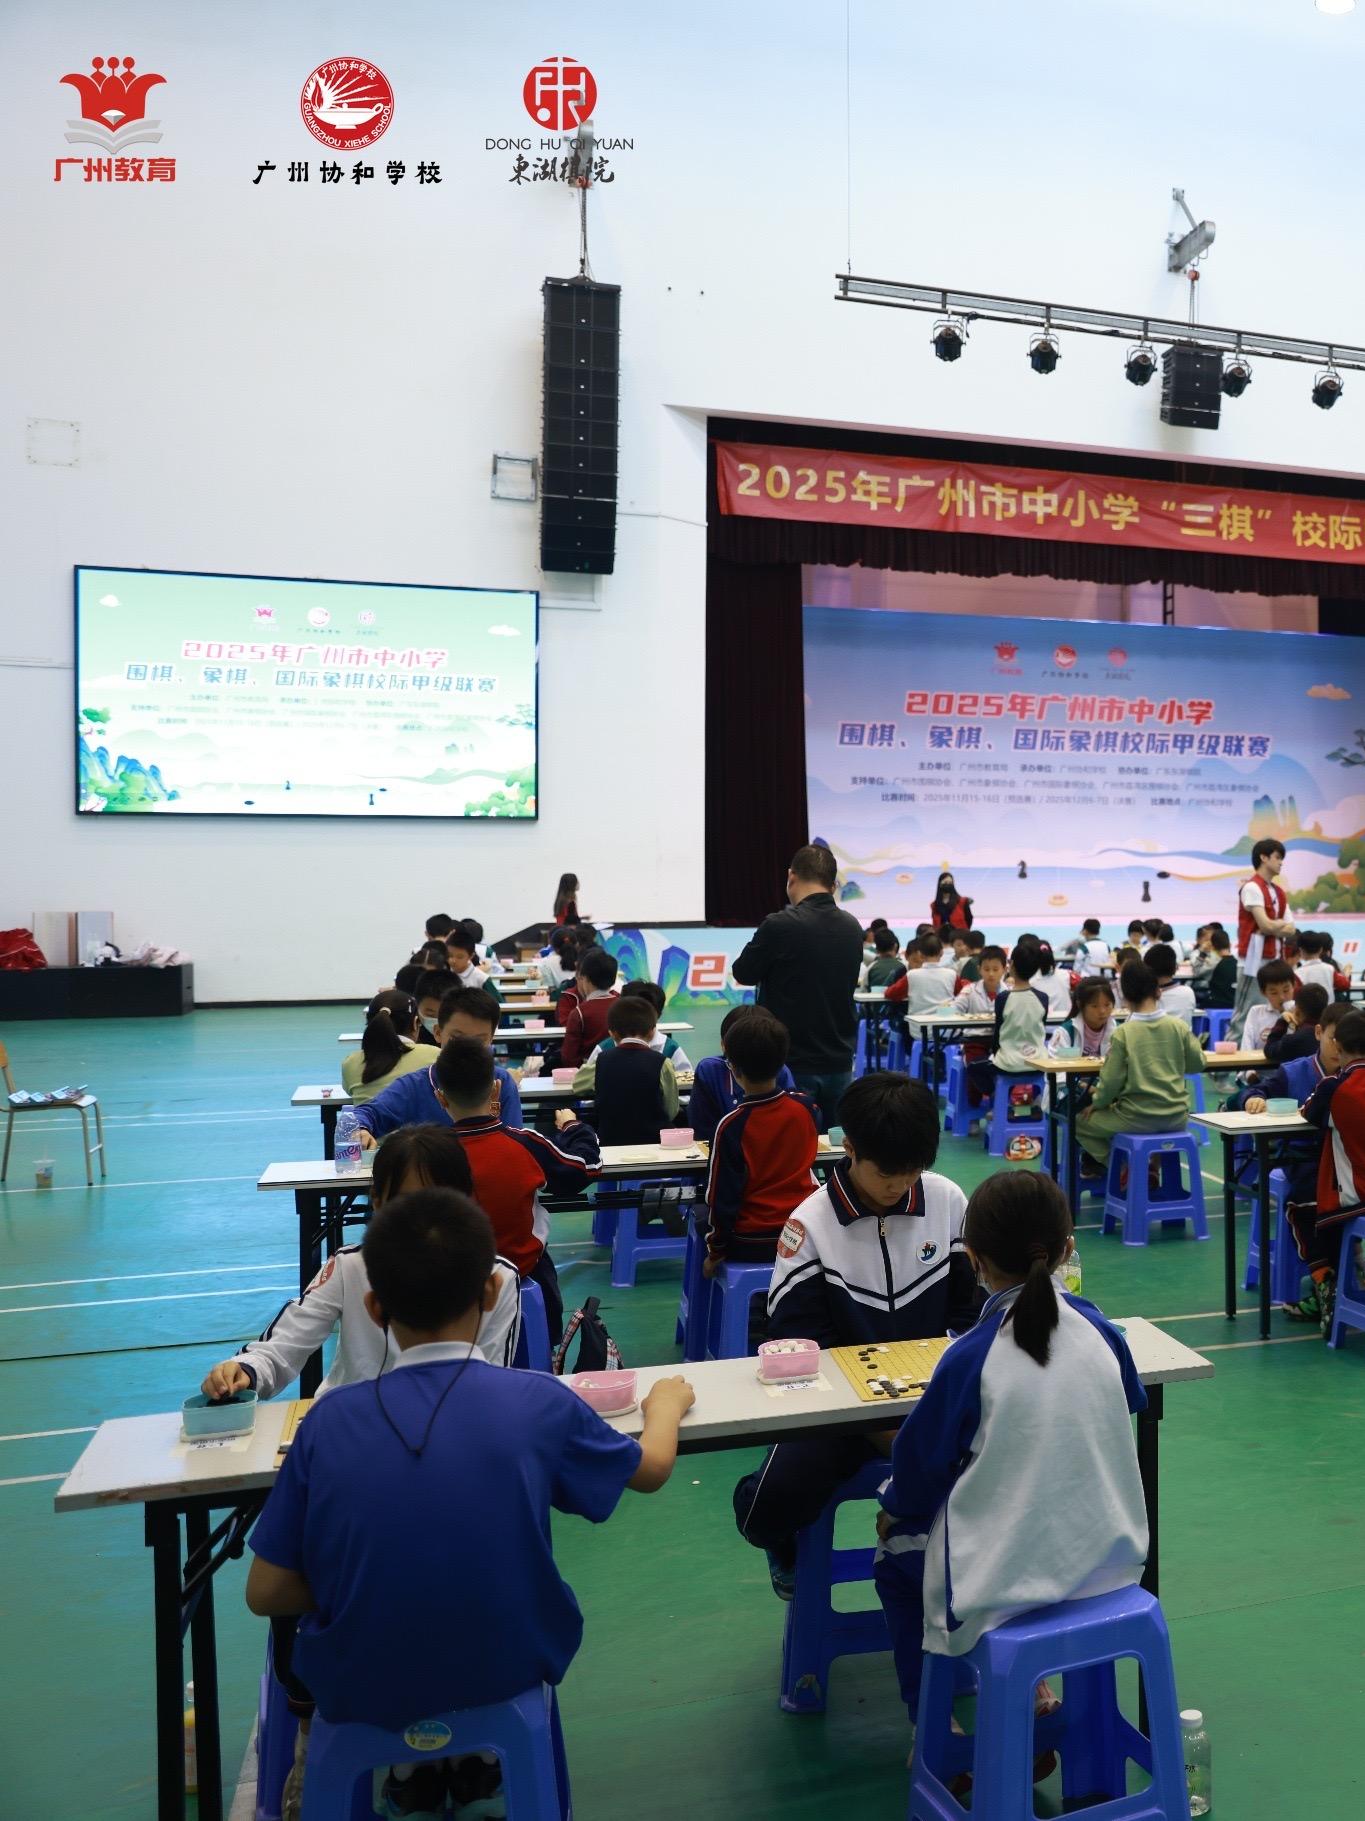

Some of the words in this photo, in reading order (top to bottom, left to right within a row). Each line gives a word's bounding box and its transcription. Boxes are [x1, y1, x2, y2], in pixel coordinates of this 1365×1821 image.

[182, 641, 448, 670] 2025年广州市中小学
[906, 690, 1215, 726] 2025年广州市中小学
[838, 722, 1271, 759] 围棋、象棋、国际象棋校际甲级联赛
